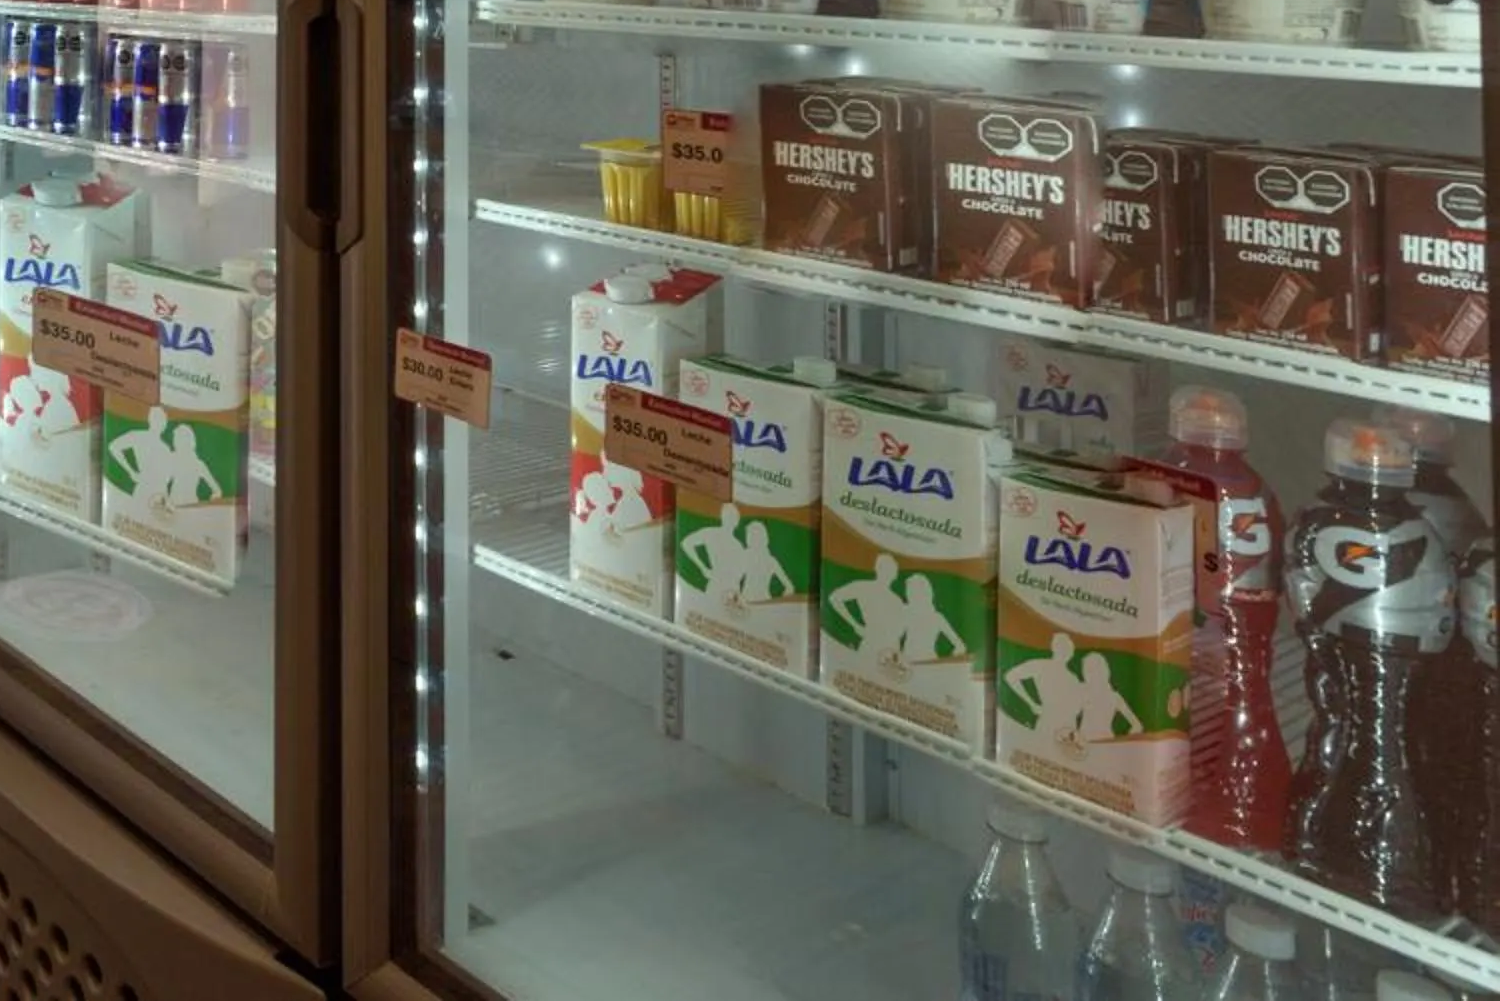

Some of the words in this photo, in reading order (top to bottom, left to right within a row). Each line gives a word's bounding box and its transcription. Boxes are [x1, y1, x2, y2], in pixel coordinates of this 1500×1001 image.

[772, 140, 875, 179] HERSHEY'S
[786, 173, 857, 193] CHOCOLATE
[948, 162, 1065, 205] HERSHEY'S
[961, 198, 1044, 220] CHOCOLATE
[1222, 214, 1341, 257] HERSHEY'S
[1402, 233, 1485, 274] HERSH
[4, 257, 82, 291] LALA
[1238, 249, 1321, 272] CHOCOLATE
[39, 318, 96, 350] $35.00
[577, 354, 653, 386] LALA
[1017, 385, 1109, 422] LALA
[612, 414, 668, 446] $35.00
[848, 457, 954, 500] LALA
[839, 490, 963, 540] deslactosada
[1024, 535, 1131, 580] LALA
[1016, 569, 1139, 619] deslactosada
